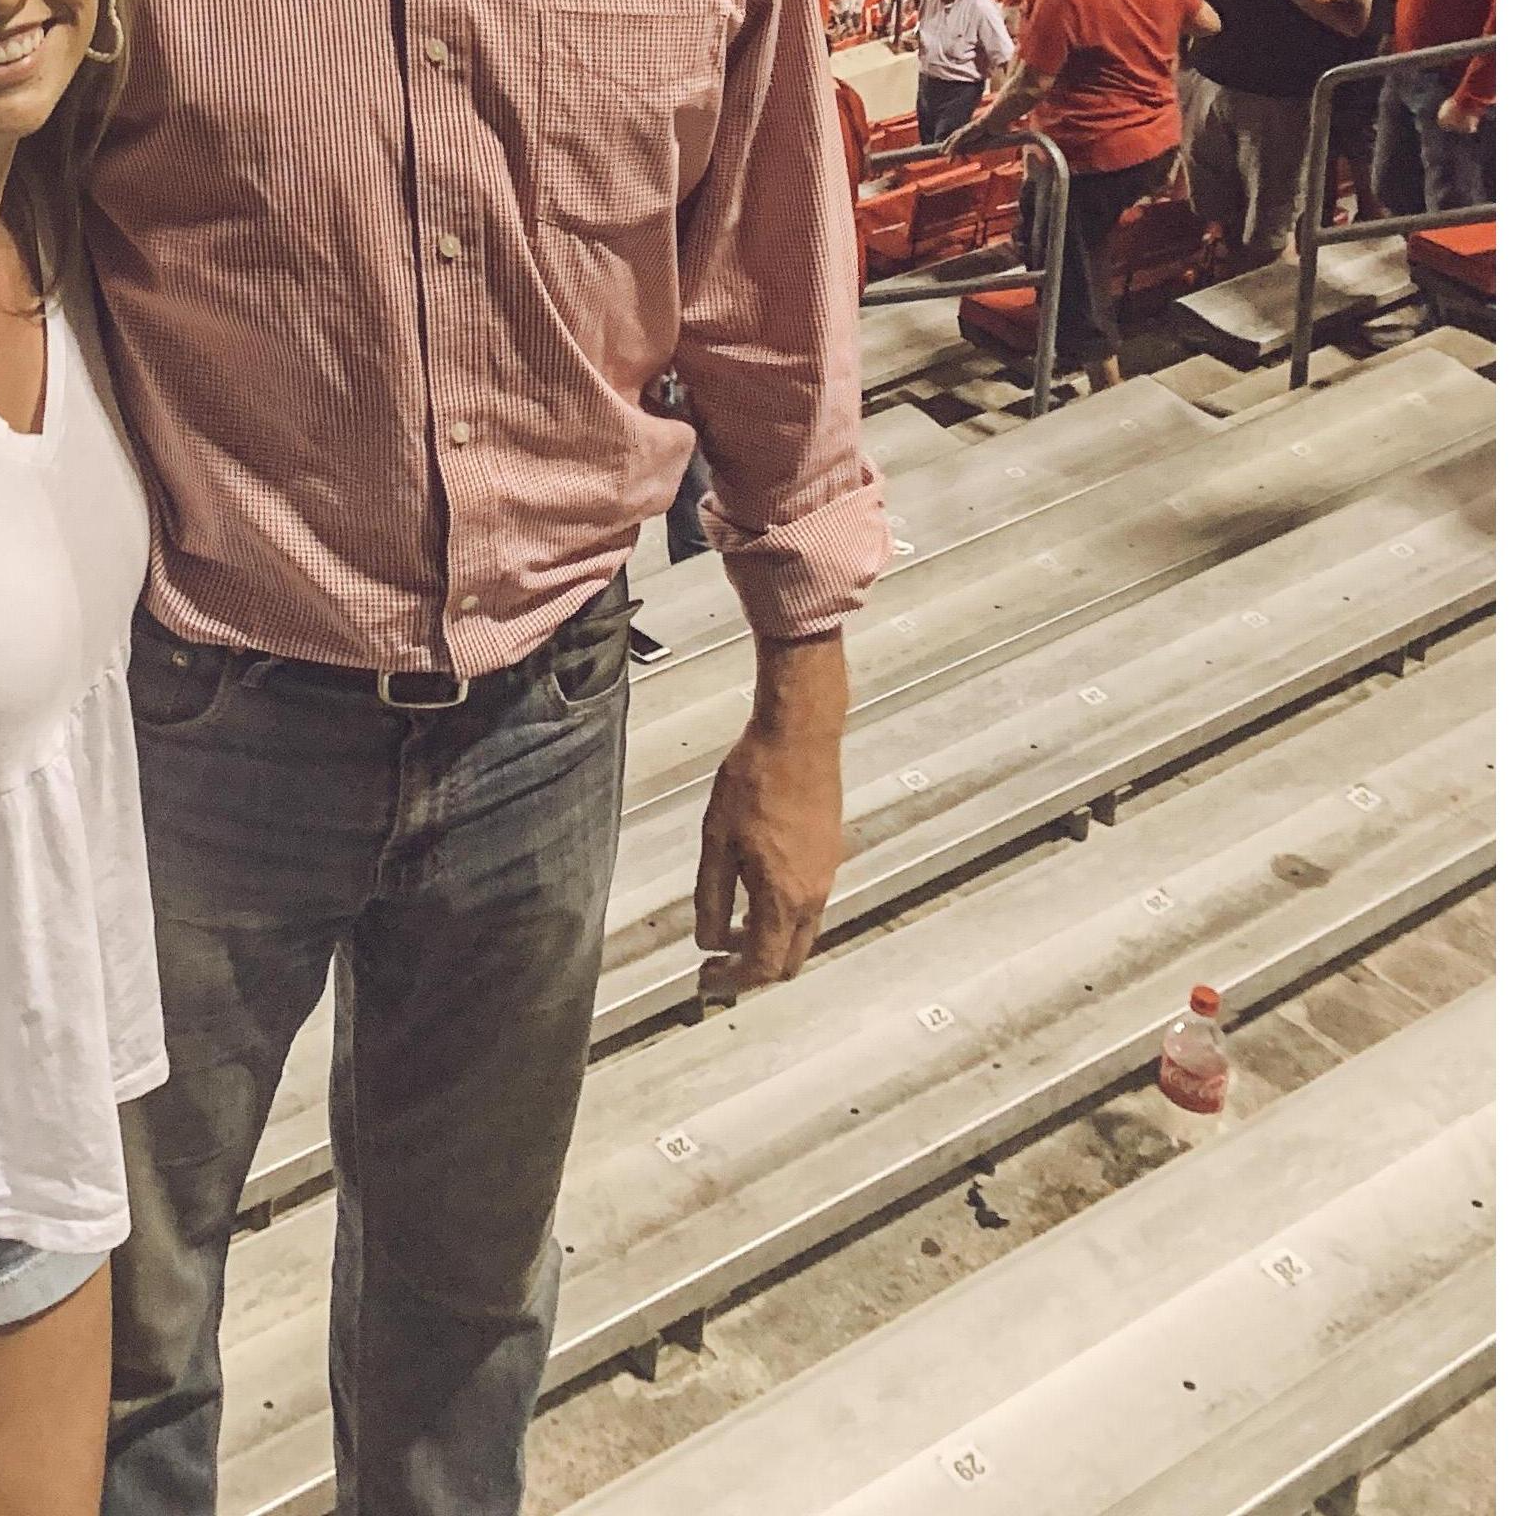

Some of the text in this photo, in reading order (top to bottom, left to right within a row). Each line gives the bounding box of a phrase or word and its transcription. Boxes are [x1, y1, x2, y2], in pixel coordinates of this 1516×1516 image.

[928, 1008, 949, 1026] 27
[667, 1137, 691, 1158] 28
[1272, 1254, 1303, 1283] 28
[953, 1453, 986, 1482] 29
